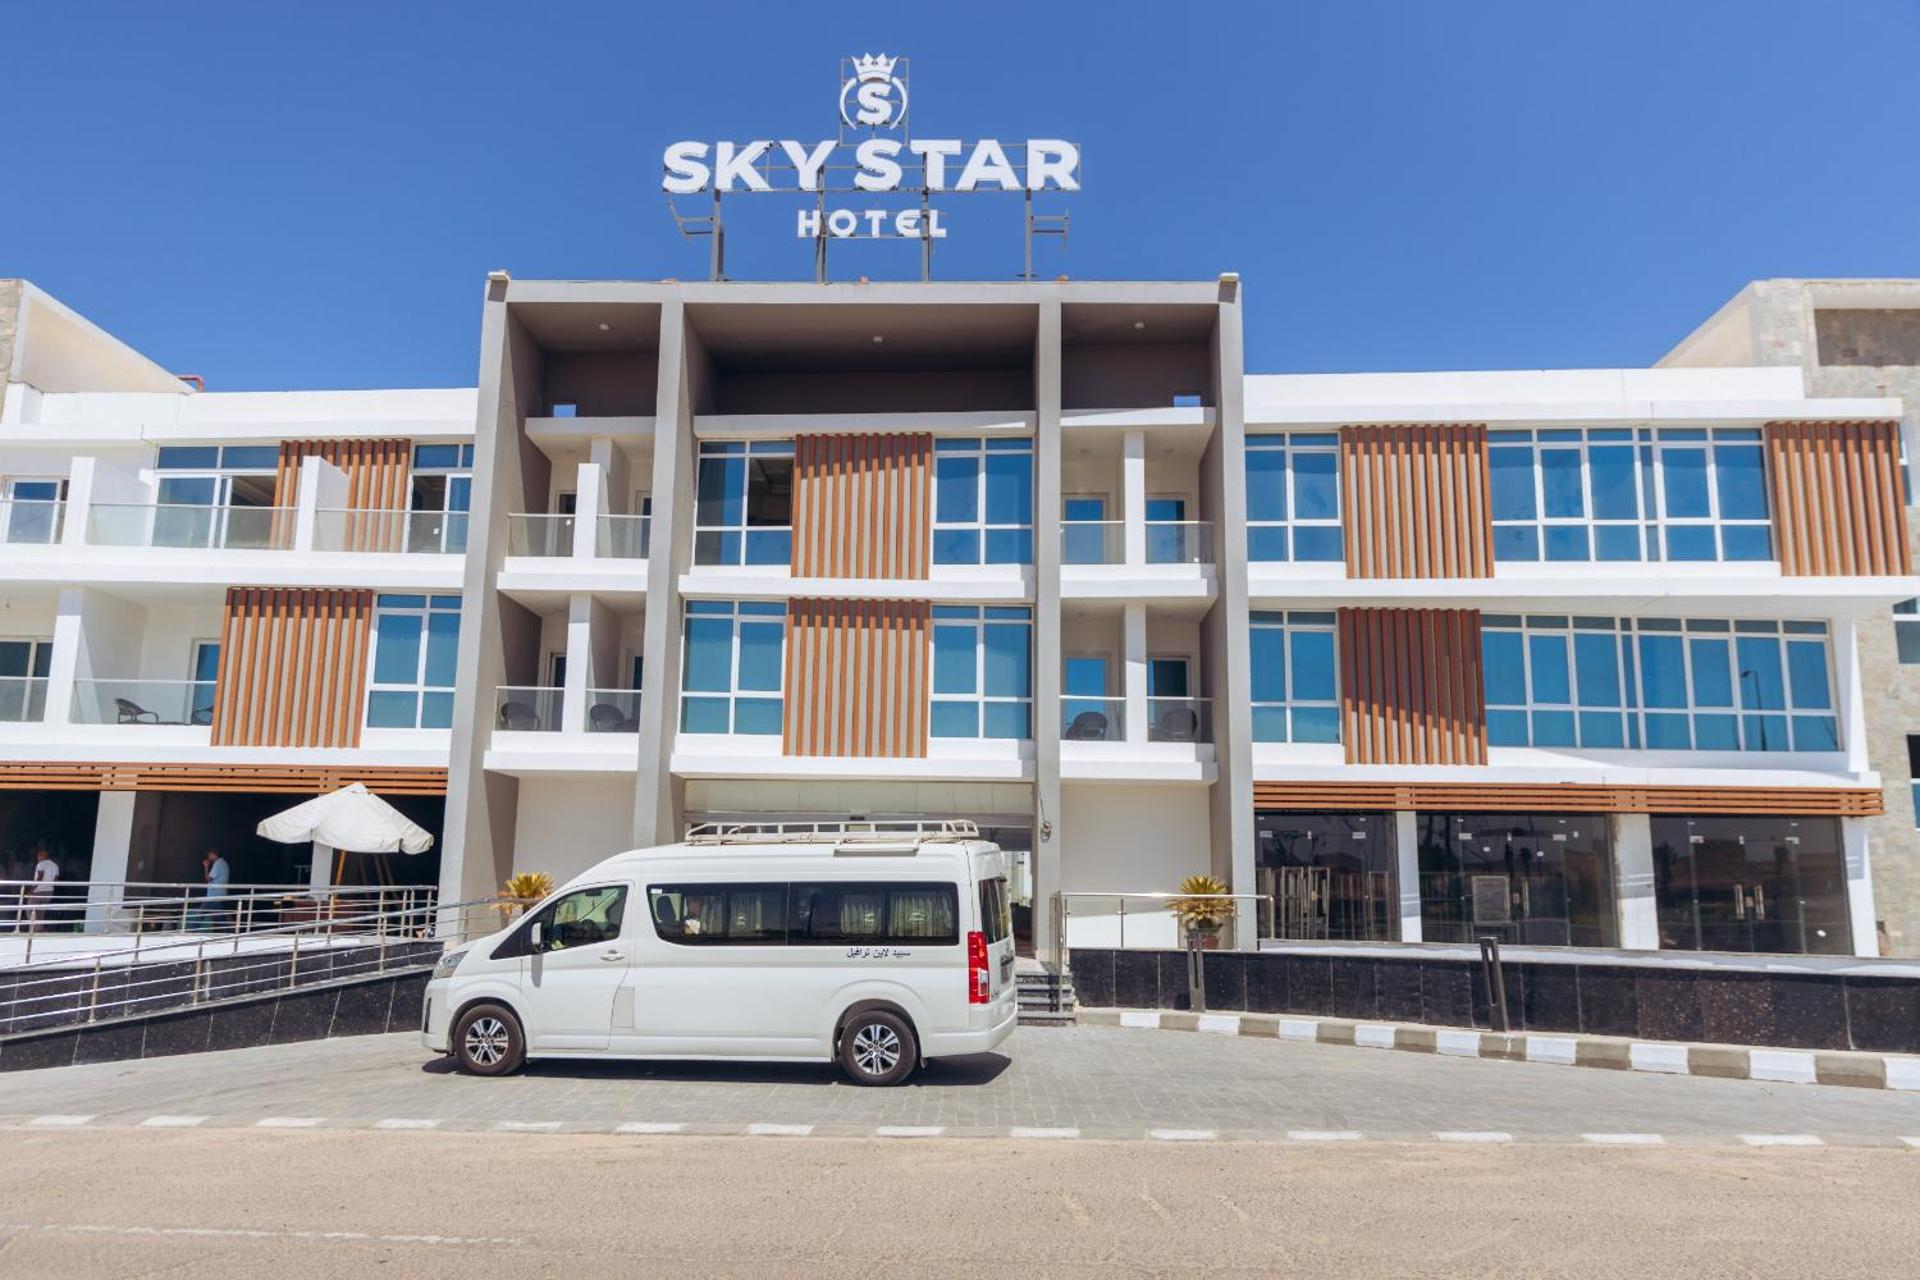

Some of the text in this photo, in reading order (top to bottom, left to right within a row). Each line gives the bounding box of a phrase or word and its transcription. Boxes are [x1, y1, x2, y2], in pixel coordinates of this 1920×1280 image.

[857, 82, 893, 125] S
[662, 138, 1081, 194] SKY STAR
[797, 208, 948, 238] HOTEL
